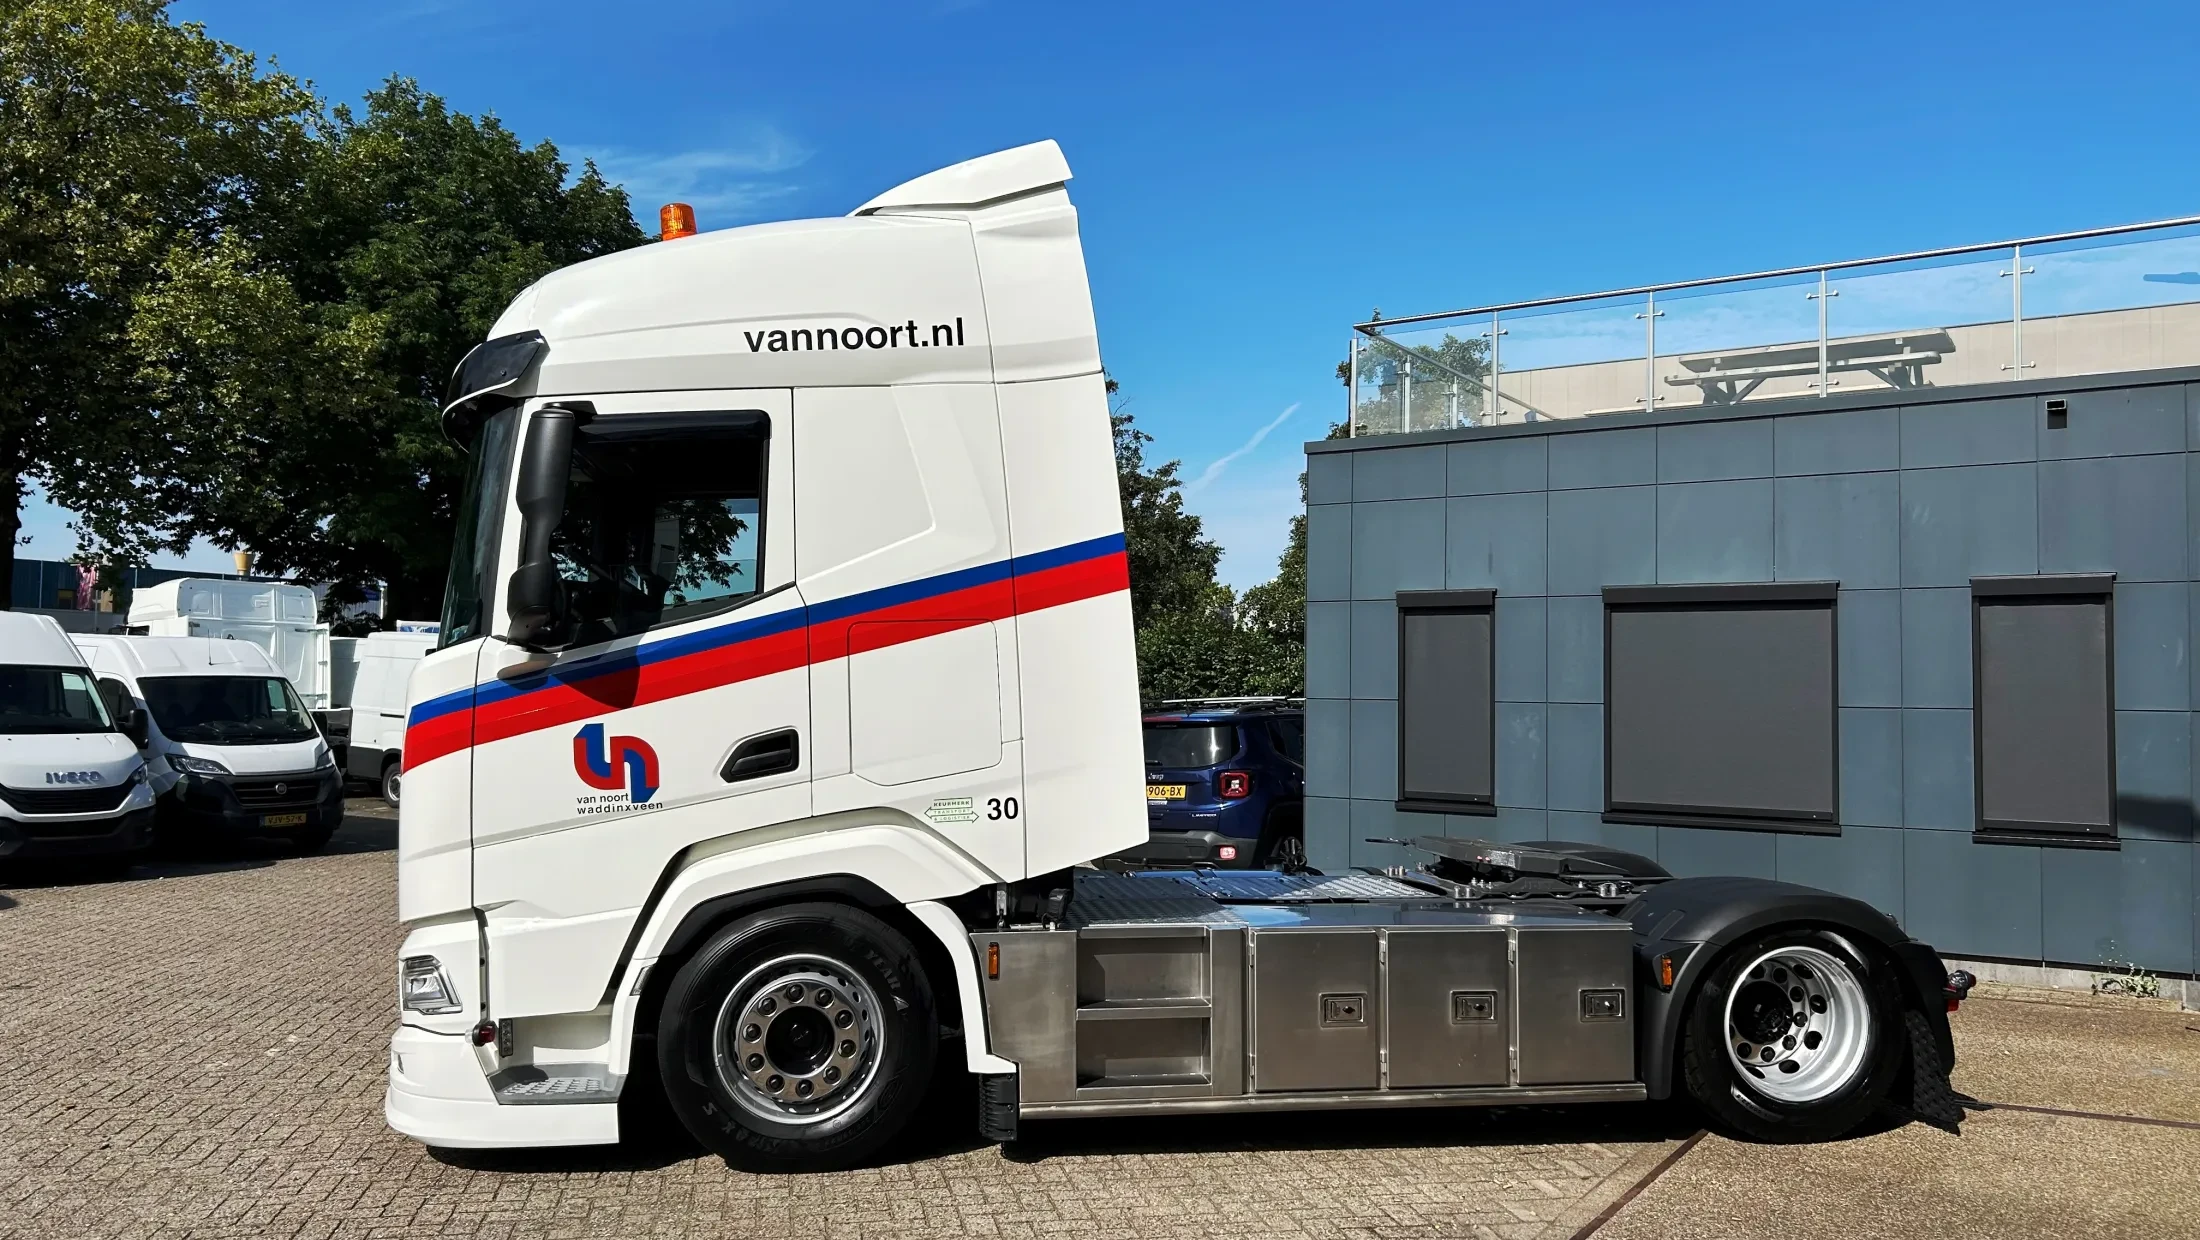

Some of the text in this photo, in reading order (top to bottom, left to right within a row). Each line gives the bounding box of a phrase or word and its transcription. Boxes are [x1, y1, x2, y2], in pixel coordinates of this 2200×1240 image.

[743, 317, 964, 353] vannoort.nl
[45, 771, 101, 784] IVECO
[576, 793, 629, 804] van noort
[577, 802, 663, 814] waddinxveen
[987, 797, 1019, 821] 30
